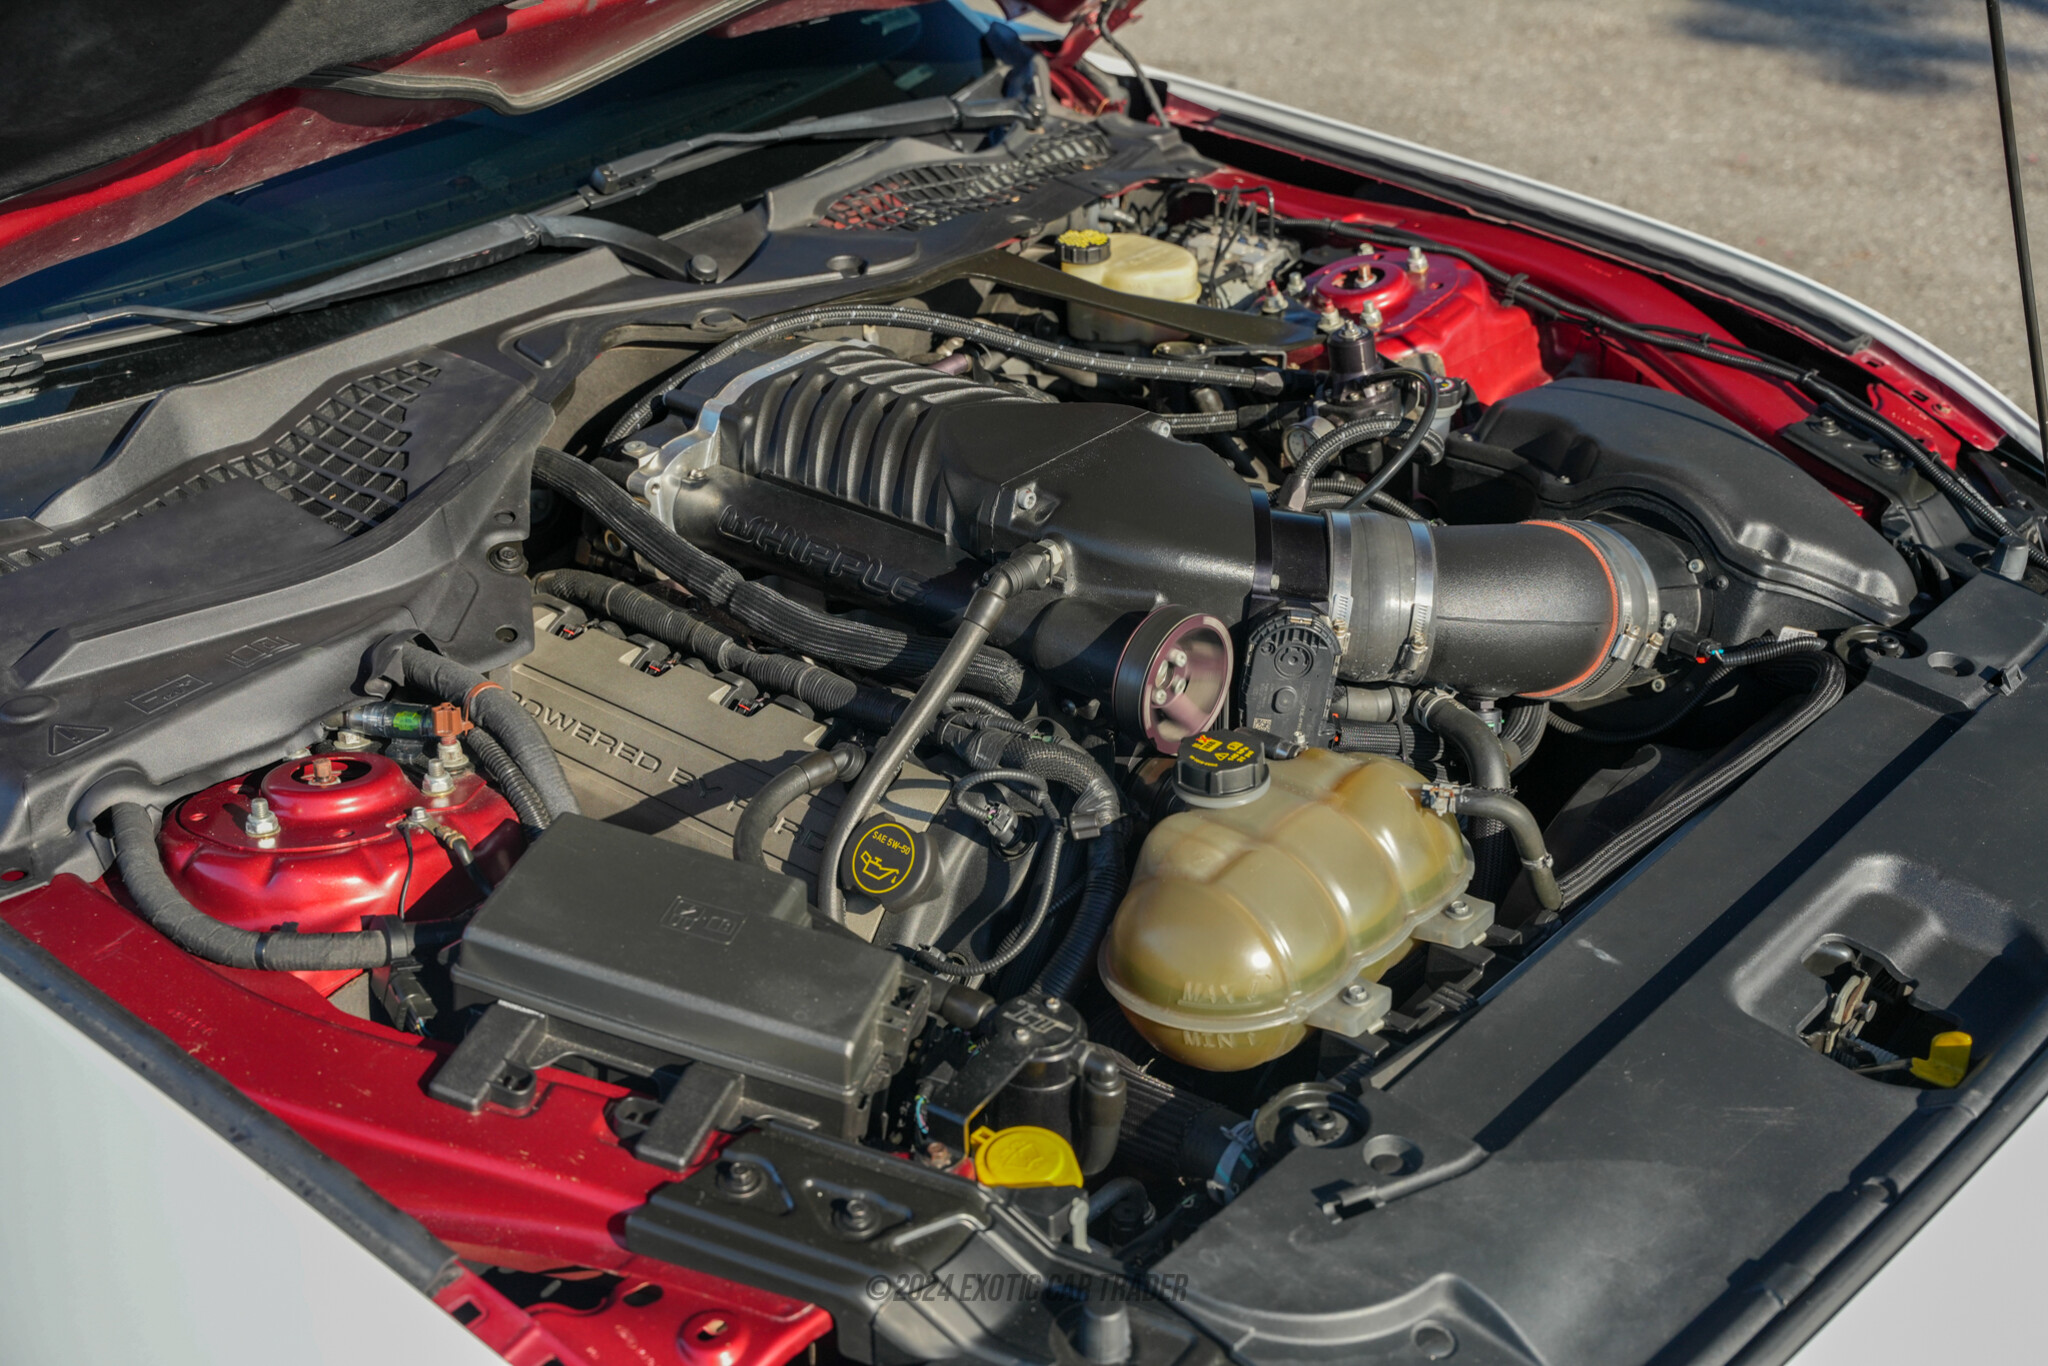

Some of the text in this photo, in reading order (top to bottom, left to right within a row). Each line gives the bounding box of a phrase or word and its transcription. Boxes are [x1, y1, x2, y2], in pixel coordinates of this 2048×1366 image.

[717, 504, 933, 603] WHIPPLE
[667, 766, 723, 799] BY
[726, 794, 828, 852] FRD
[872, 831, 911, 855] SAE 5W-50
[1182, 981, 1235, 1004] MAX
[1182, 1030, 1235, 1049] MIN
